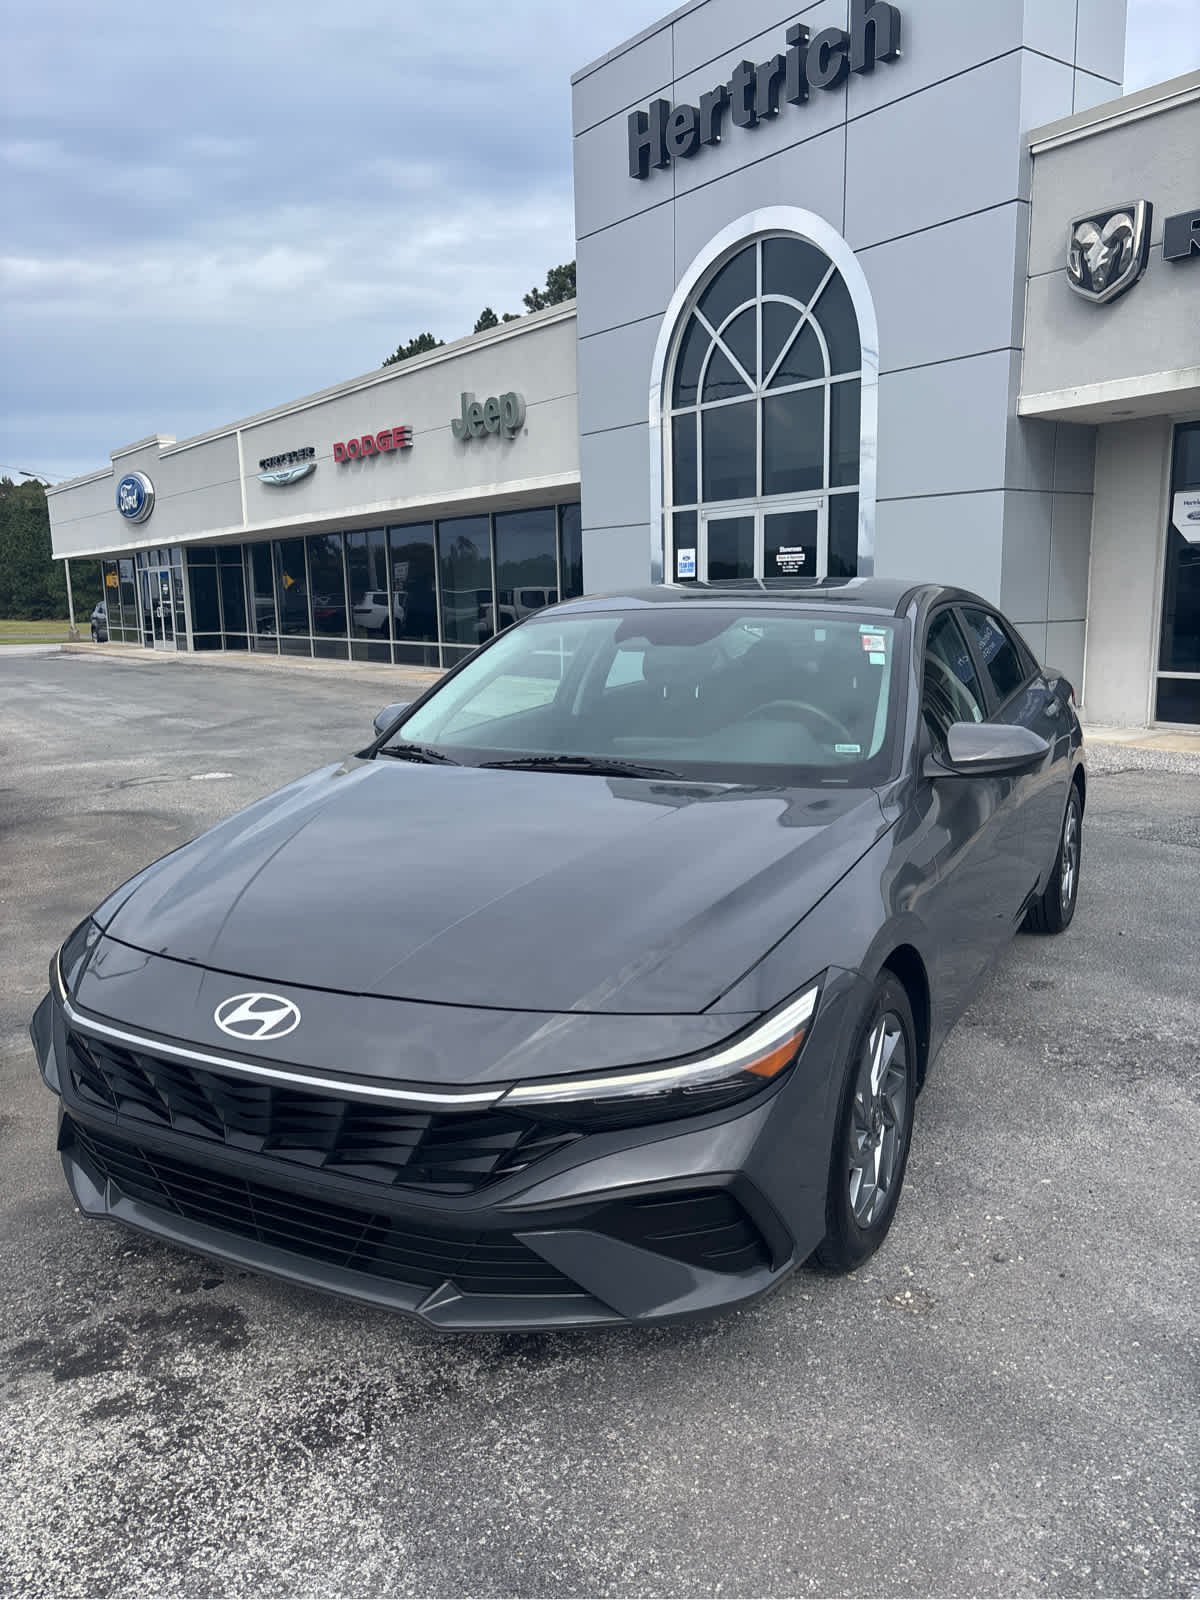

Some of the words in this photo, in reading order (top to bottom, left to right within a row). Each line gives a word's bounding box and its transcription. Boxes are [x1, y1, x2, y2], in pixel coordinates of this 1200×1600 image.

[628, 0, 902, 179] Hertrich
[451, 391, 526, 440] Jeep
[333, 425, 413, 463] DODGE
[120, 483, 138, 511] Ford
